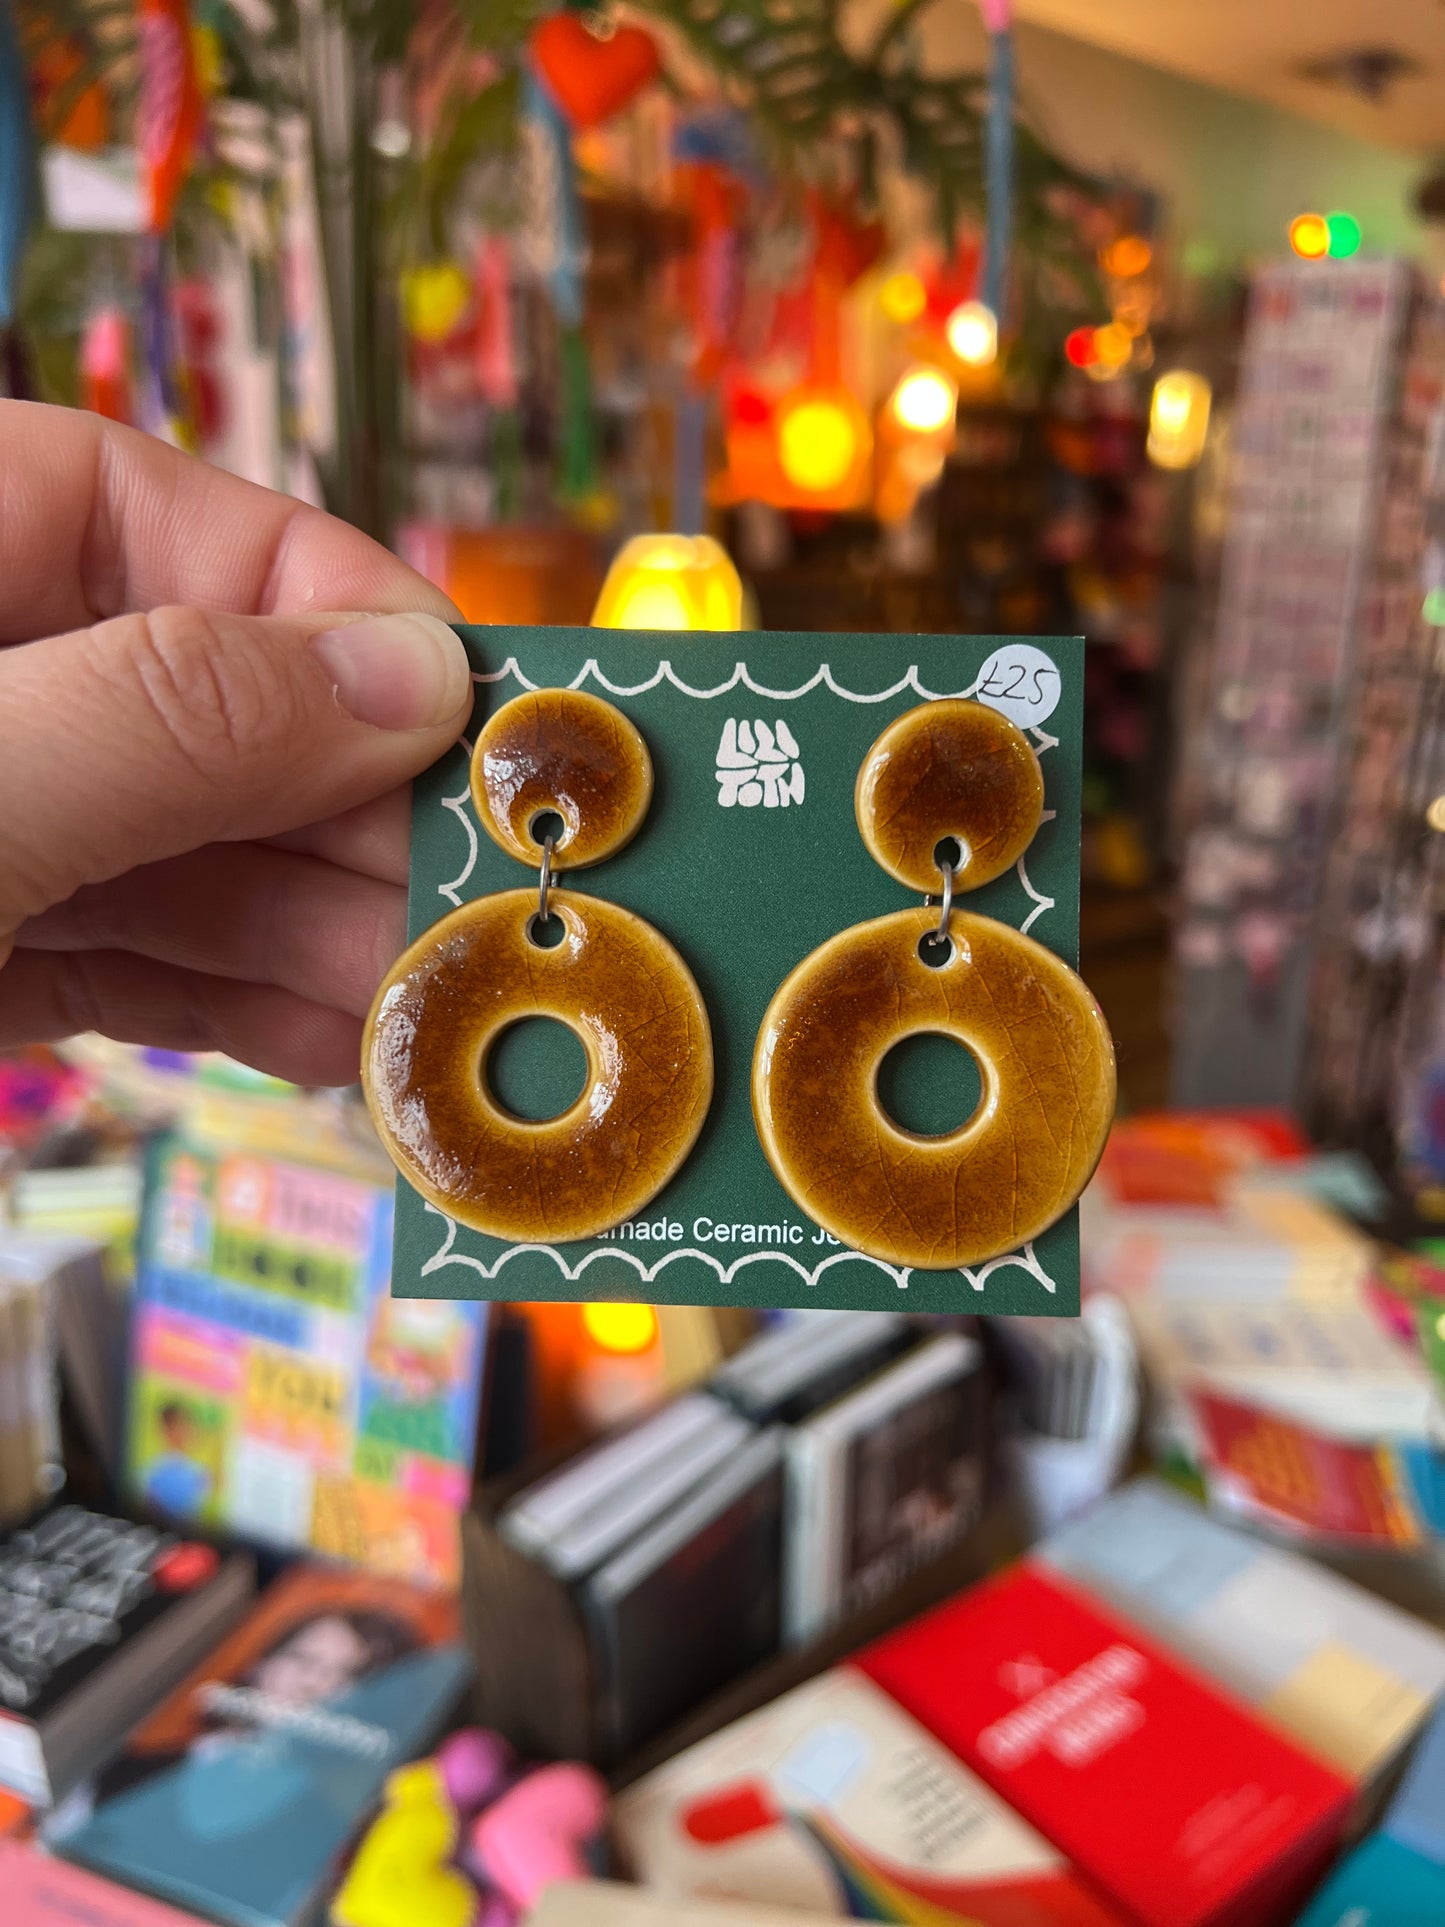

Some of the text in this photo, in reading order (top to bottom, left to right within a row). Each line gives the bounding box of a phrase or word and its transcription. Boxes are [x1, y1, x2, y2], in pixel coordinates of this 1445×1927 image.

[978, 660, 1058, 705] £25
[596, 1216, 684, 1241] made
[692, 1217, 804, 1245] Ceramic
